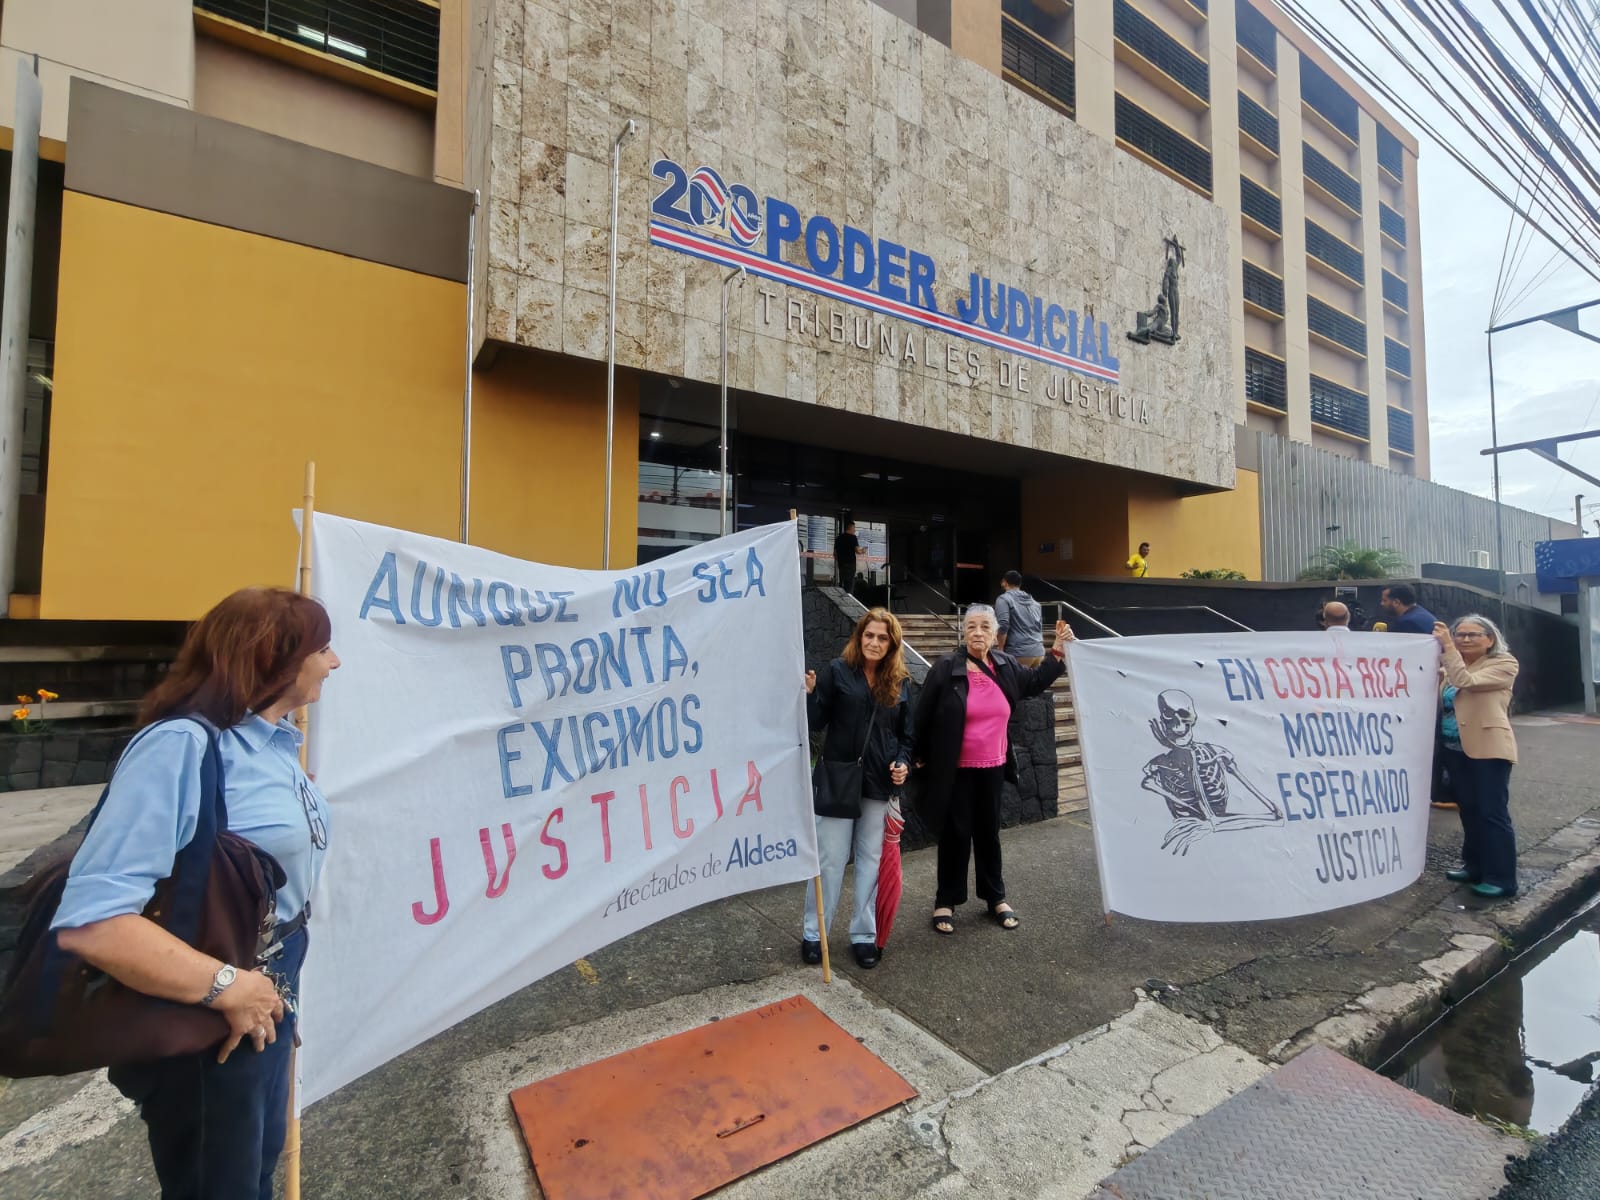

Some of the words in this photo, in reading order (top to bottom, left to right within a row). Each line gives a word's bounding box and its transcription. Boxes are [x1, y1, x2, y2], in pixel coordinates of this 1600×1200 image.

[651, 159, 762, 248] 200
[766, 196, 937, 310] PODER
[957, 273, 1119, 368] JUDICIAL
[759, 289, 983, 379] TRIBUNALES
[998, 359, 1029, 393] DE
[1045, 376, 1150, 426] JUSTICIA
[360, 552, 579, 627] AUNQUE
[692, 547, 767, 603] SEA
[500, 626, 700, 708] PRONTA,
[1218, 658, 1264, 701] EN
[1265, 657, 1354, 700] COSTA
[1356, 658, 1410, 699] RICA
[497, 693, 704, 798] EXIGIMOS
[1280, 712, 1394, 758] MORIMOS
[1277, 769, 1410, 821] ESPERANDO
[412, 760, 764, 925] JUSTICIA
[602, 863, 697, 918] Afectados
[702, 852, 723, 880] de
[725, 834, 798, 873] Aldesa
[1315, 826, 1403, 884] JUSTICIA
